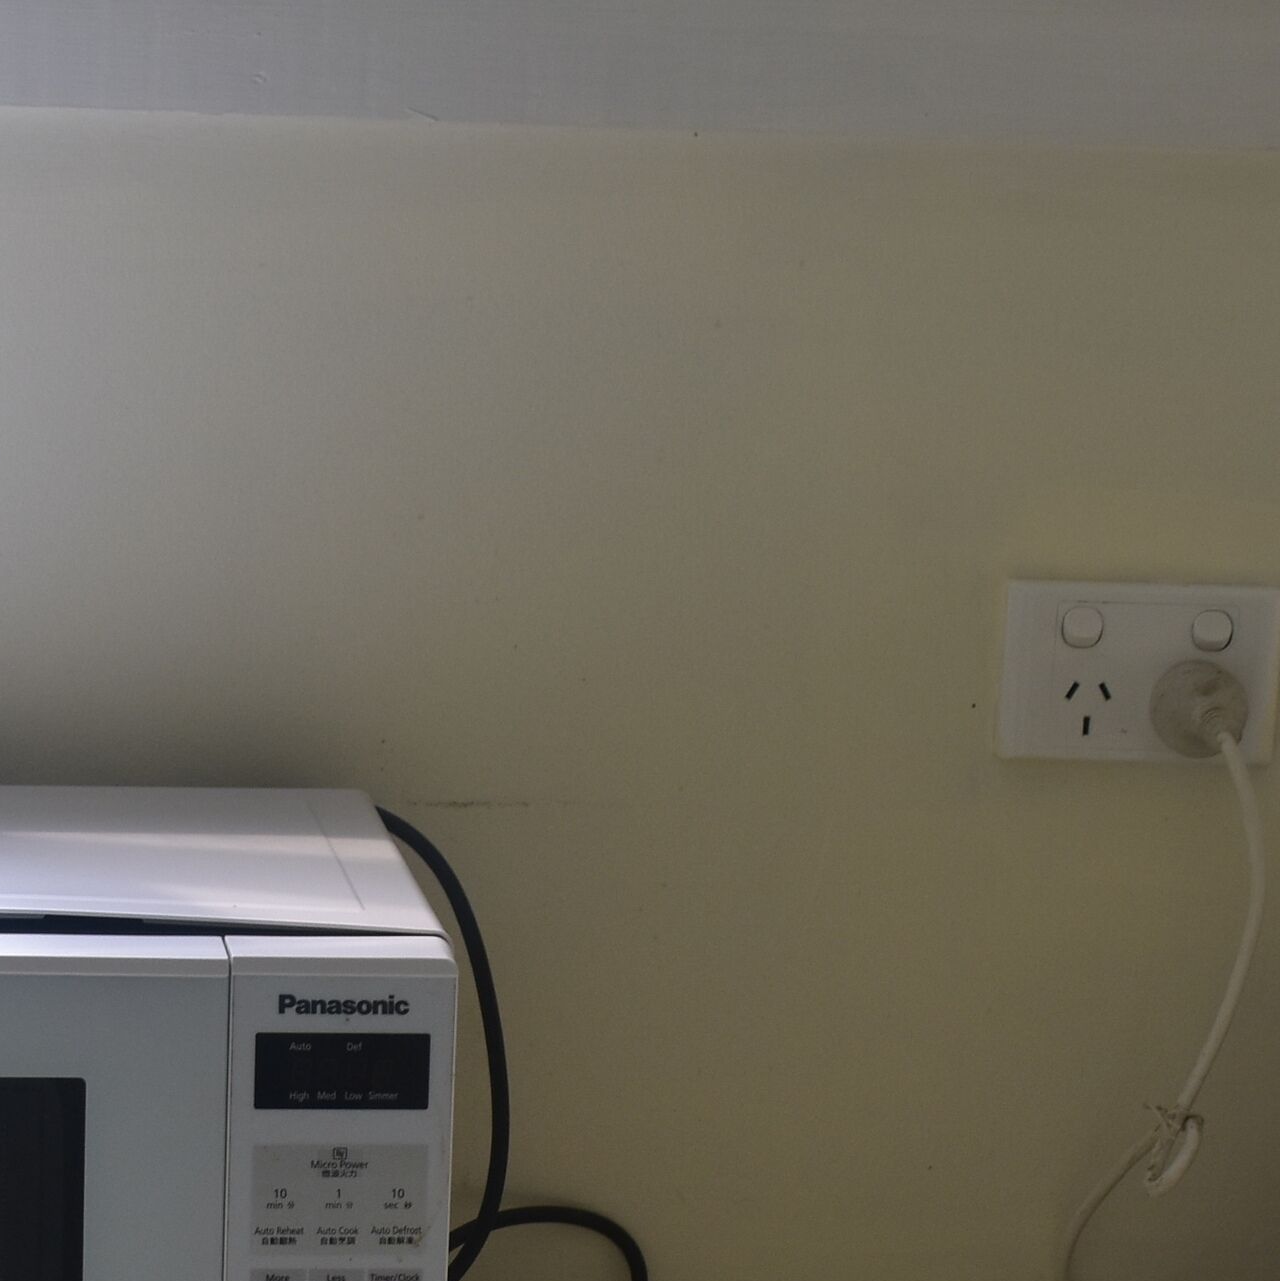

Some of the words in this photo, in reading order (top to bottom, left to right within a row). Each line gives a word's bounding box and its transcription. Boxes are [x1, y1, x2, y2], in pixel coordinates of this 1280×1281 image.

[278, 994, 409, 1015] Panasonic
[289, 1042, 312, 1050] Auto
[346, 1042, 362, 1052] Def
[289, 1092, 309, 1100] High
[311, 1160, 337, 1169] Micro
[340, 1160, 368, 1169] Power
[274, 1189, 287, 1198] 10
[336, 1189, 341, 1198] 1
[392, 1189, 405, 1198] 10
[255, 1227, 274, 1235] Auto
[276, 1227, 304, 1235] Reheat
[316, 1227, 336, 1235] Auto
[338, 1227, 358, 1235] Cook
[372, 1227, 390, 1235] Auto
[392, 1226, 421, 1235] Defrost
